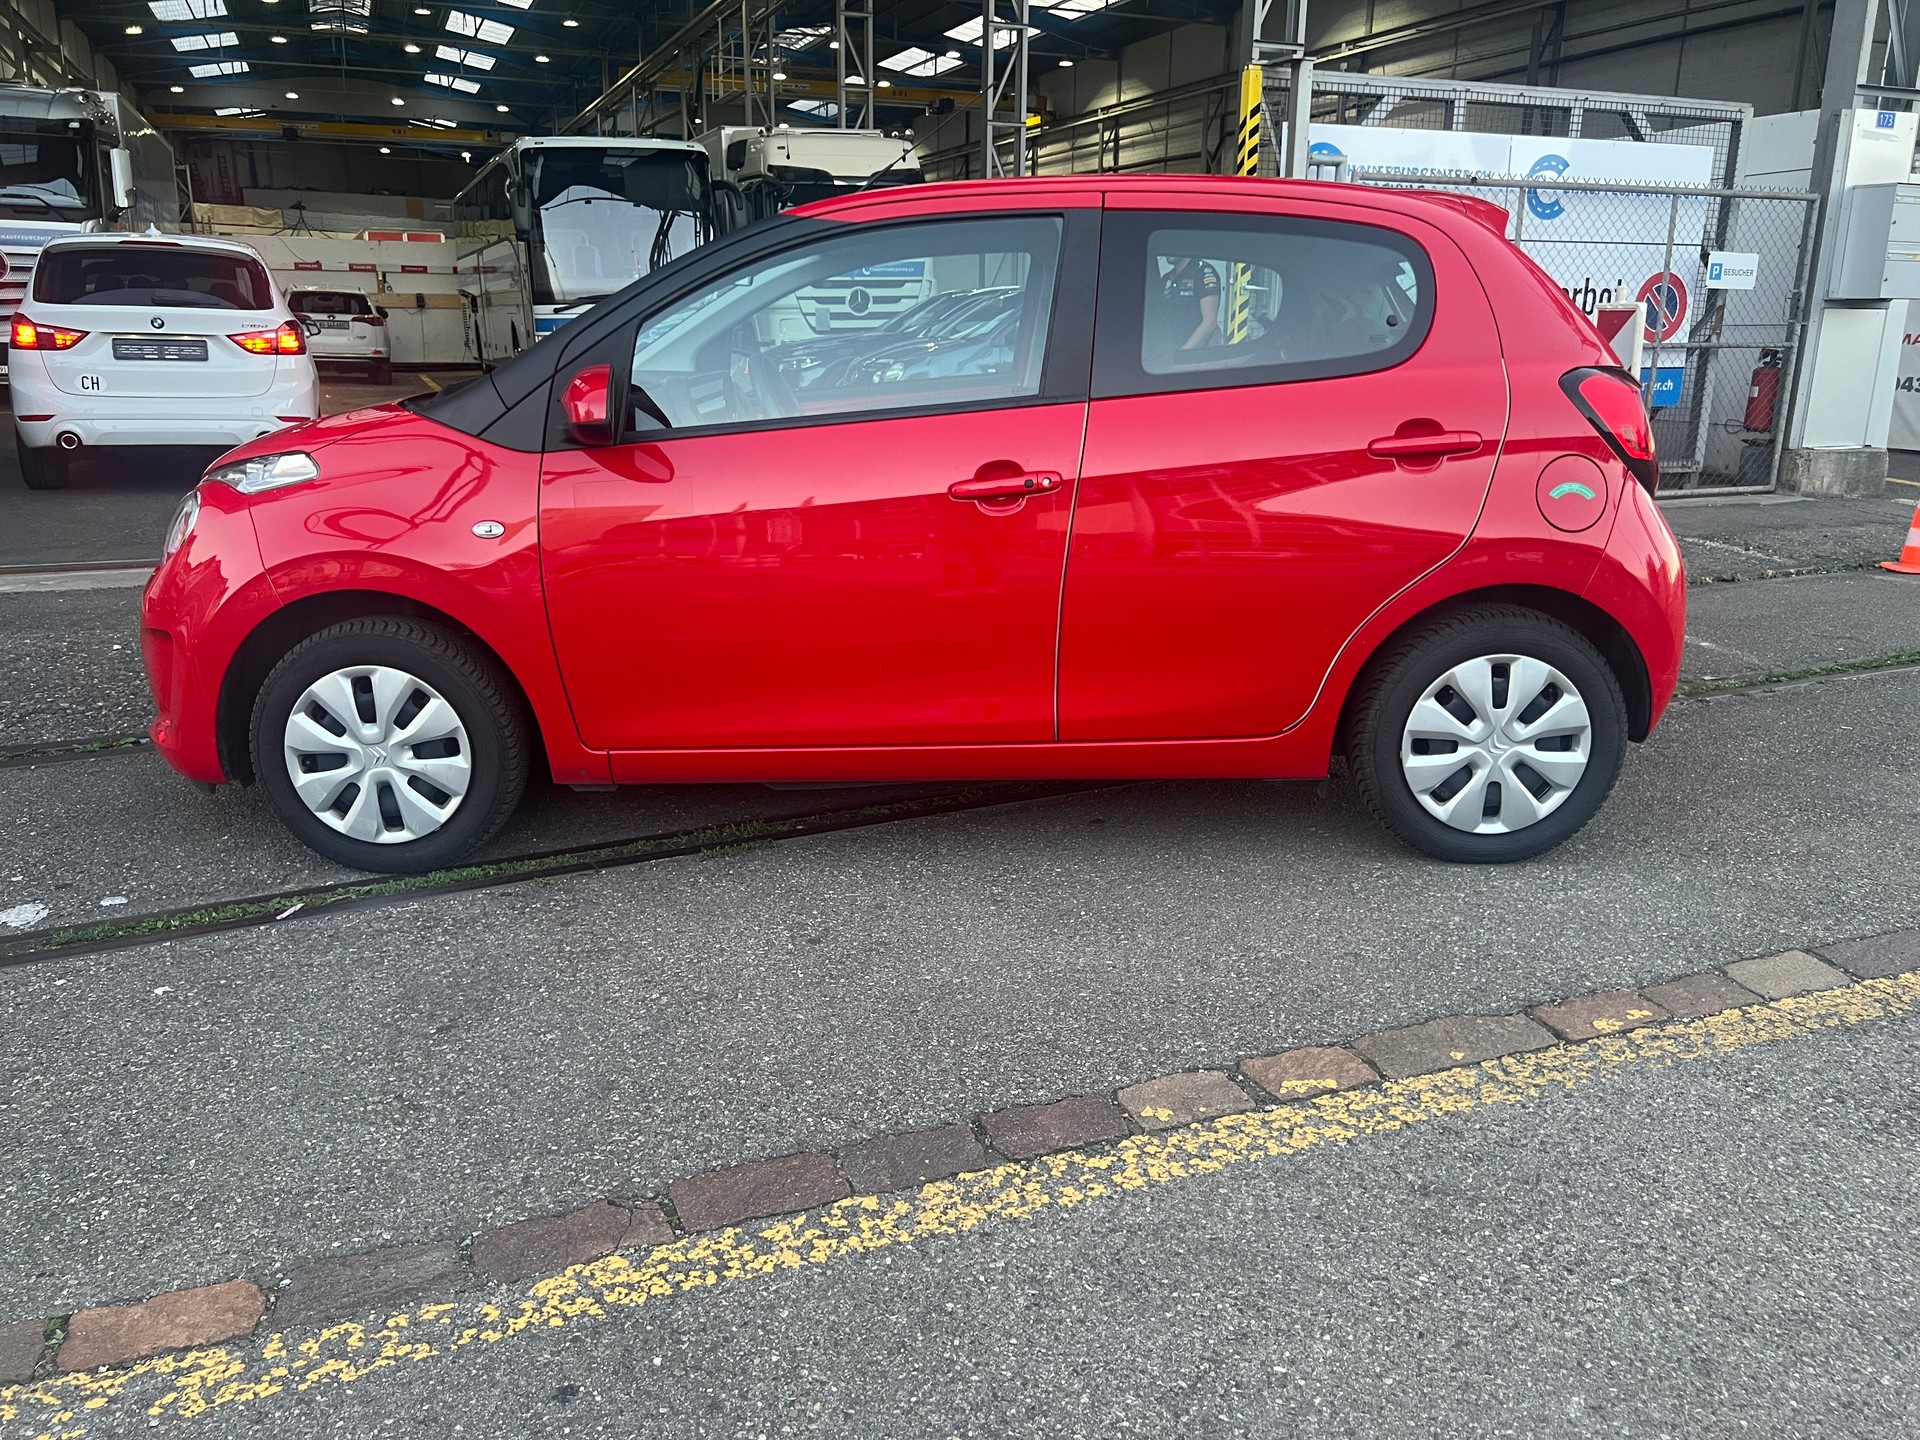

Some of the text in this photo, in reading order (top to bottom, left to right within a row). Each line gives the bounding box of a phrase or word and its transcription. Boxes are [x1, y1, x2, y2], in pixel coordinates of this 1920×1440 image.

[1880, 113, 1894, 127] 173
[1712, 265, 1754, 279] P BESUCHER
[80, 375, 100, 391] CH
